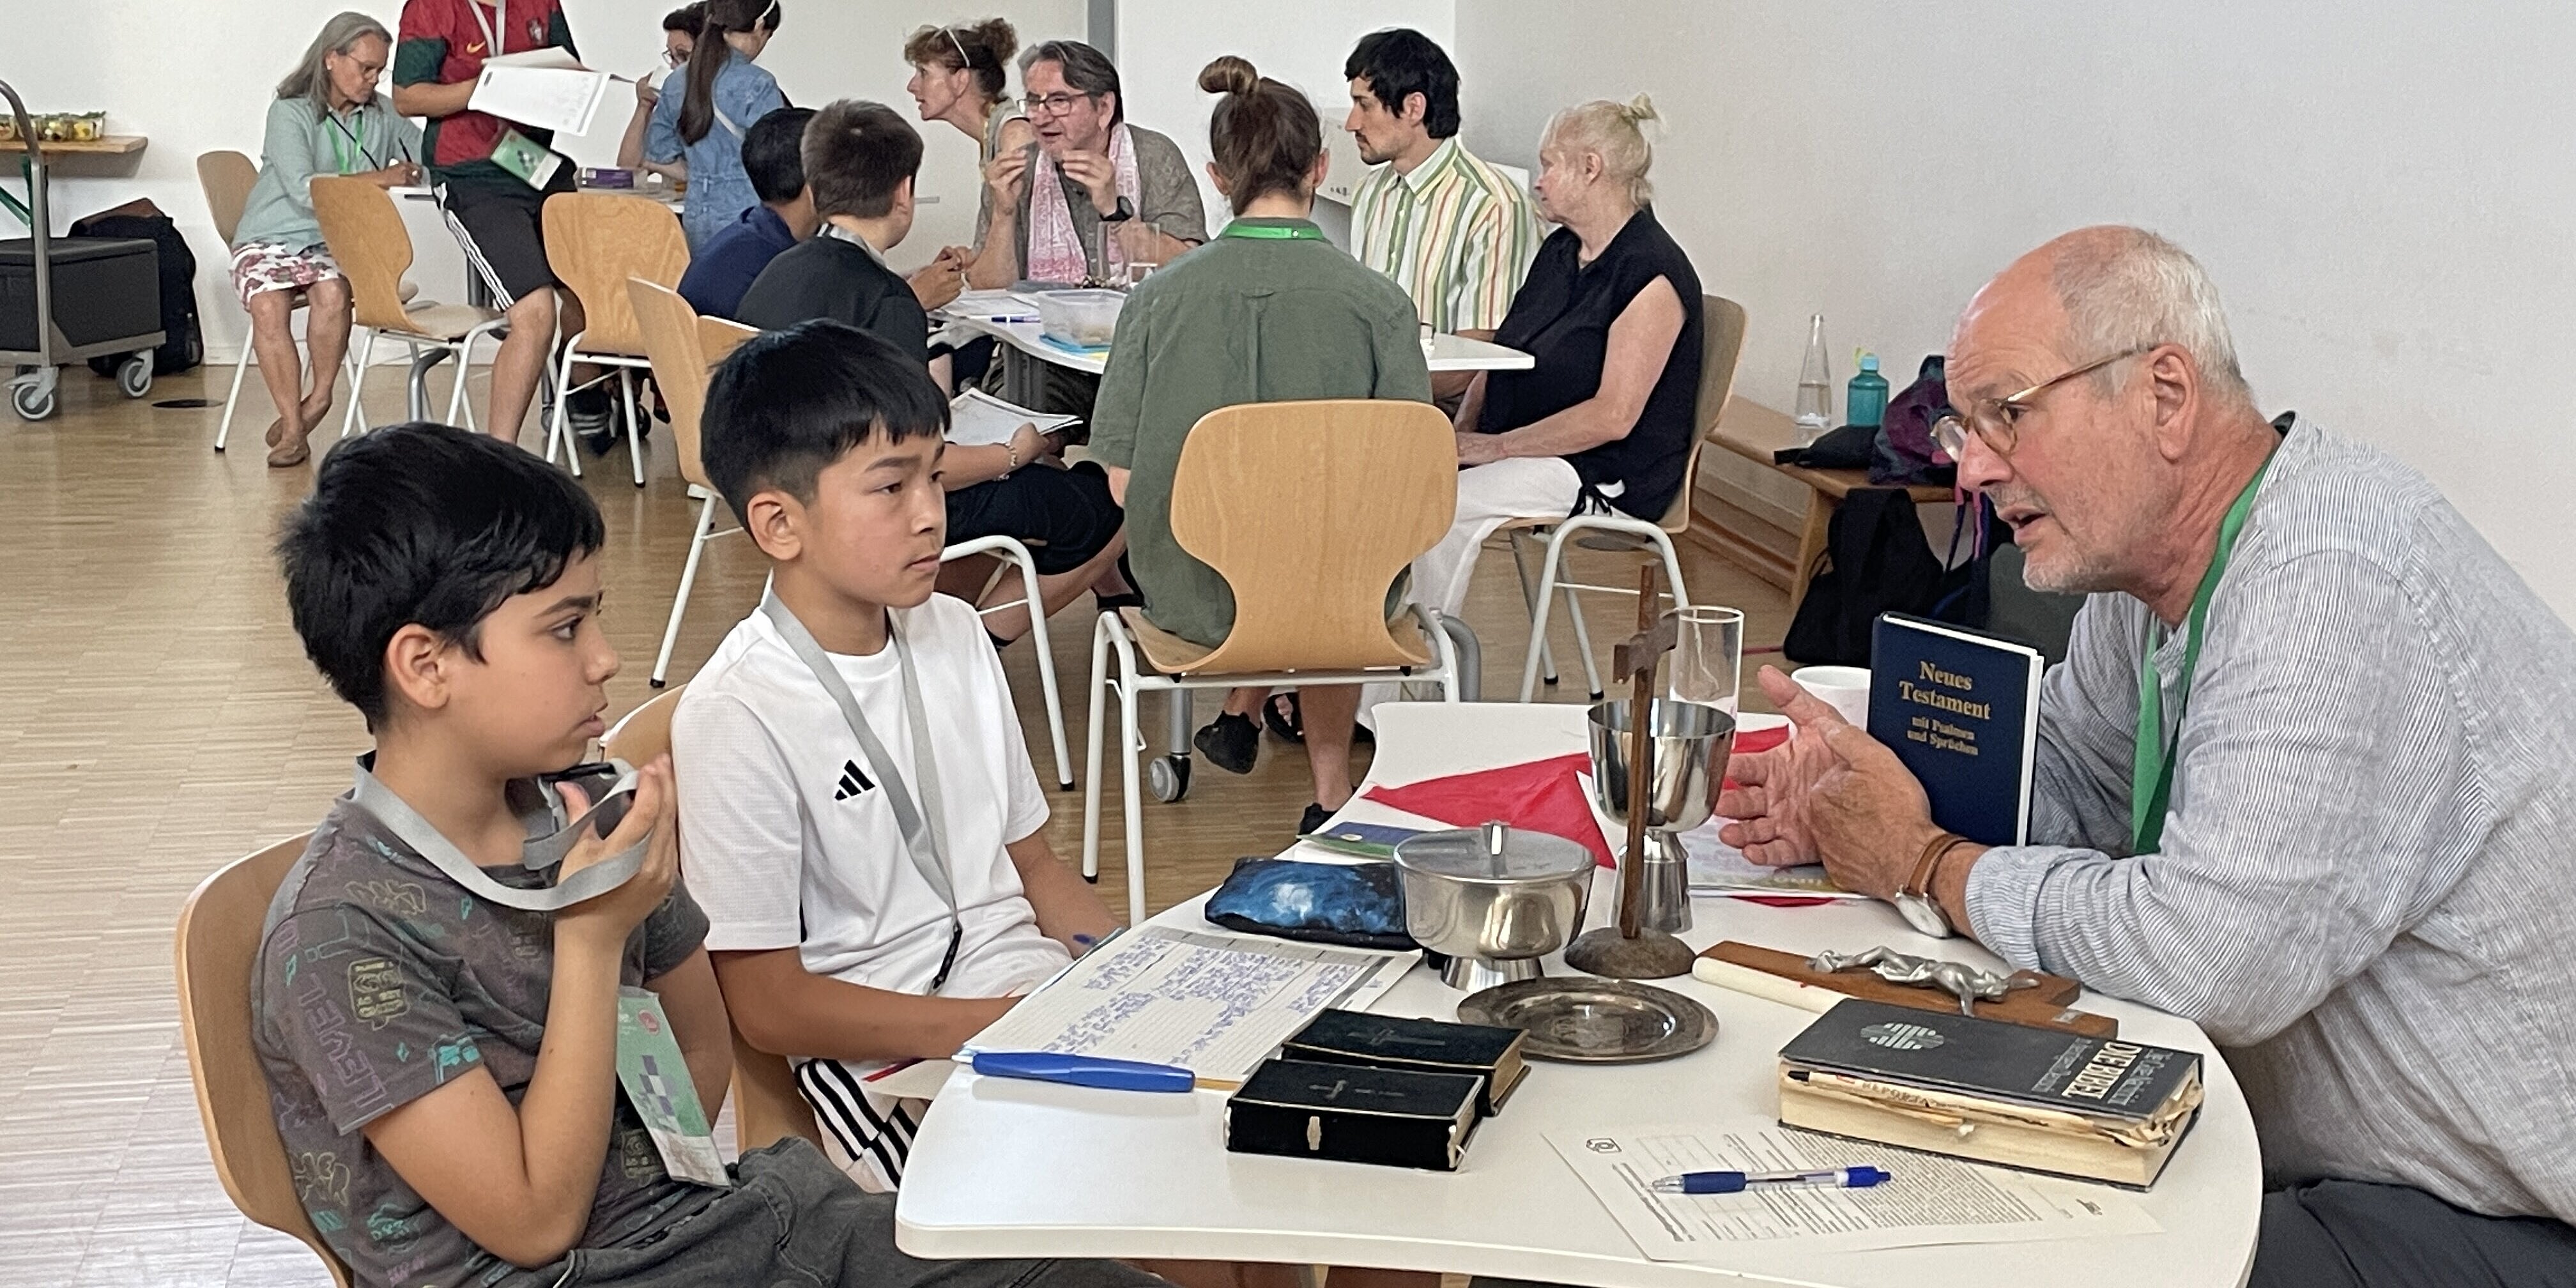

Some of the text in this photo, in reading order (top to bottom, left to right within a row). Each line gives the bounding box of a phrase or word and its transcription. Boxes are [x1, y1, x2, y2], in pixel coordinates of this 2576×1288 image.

[1919, 661, 1973, 691] Neues
[1899, 680, 1991, 720] Testament
[298, 972, 387, 1108] LEVEL
[2092, 1041, 2143, 1068] DIE
[2061, 1062, 2126, 1100] BIBEL
